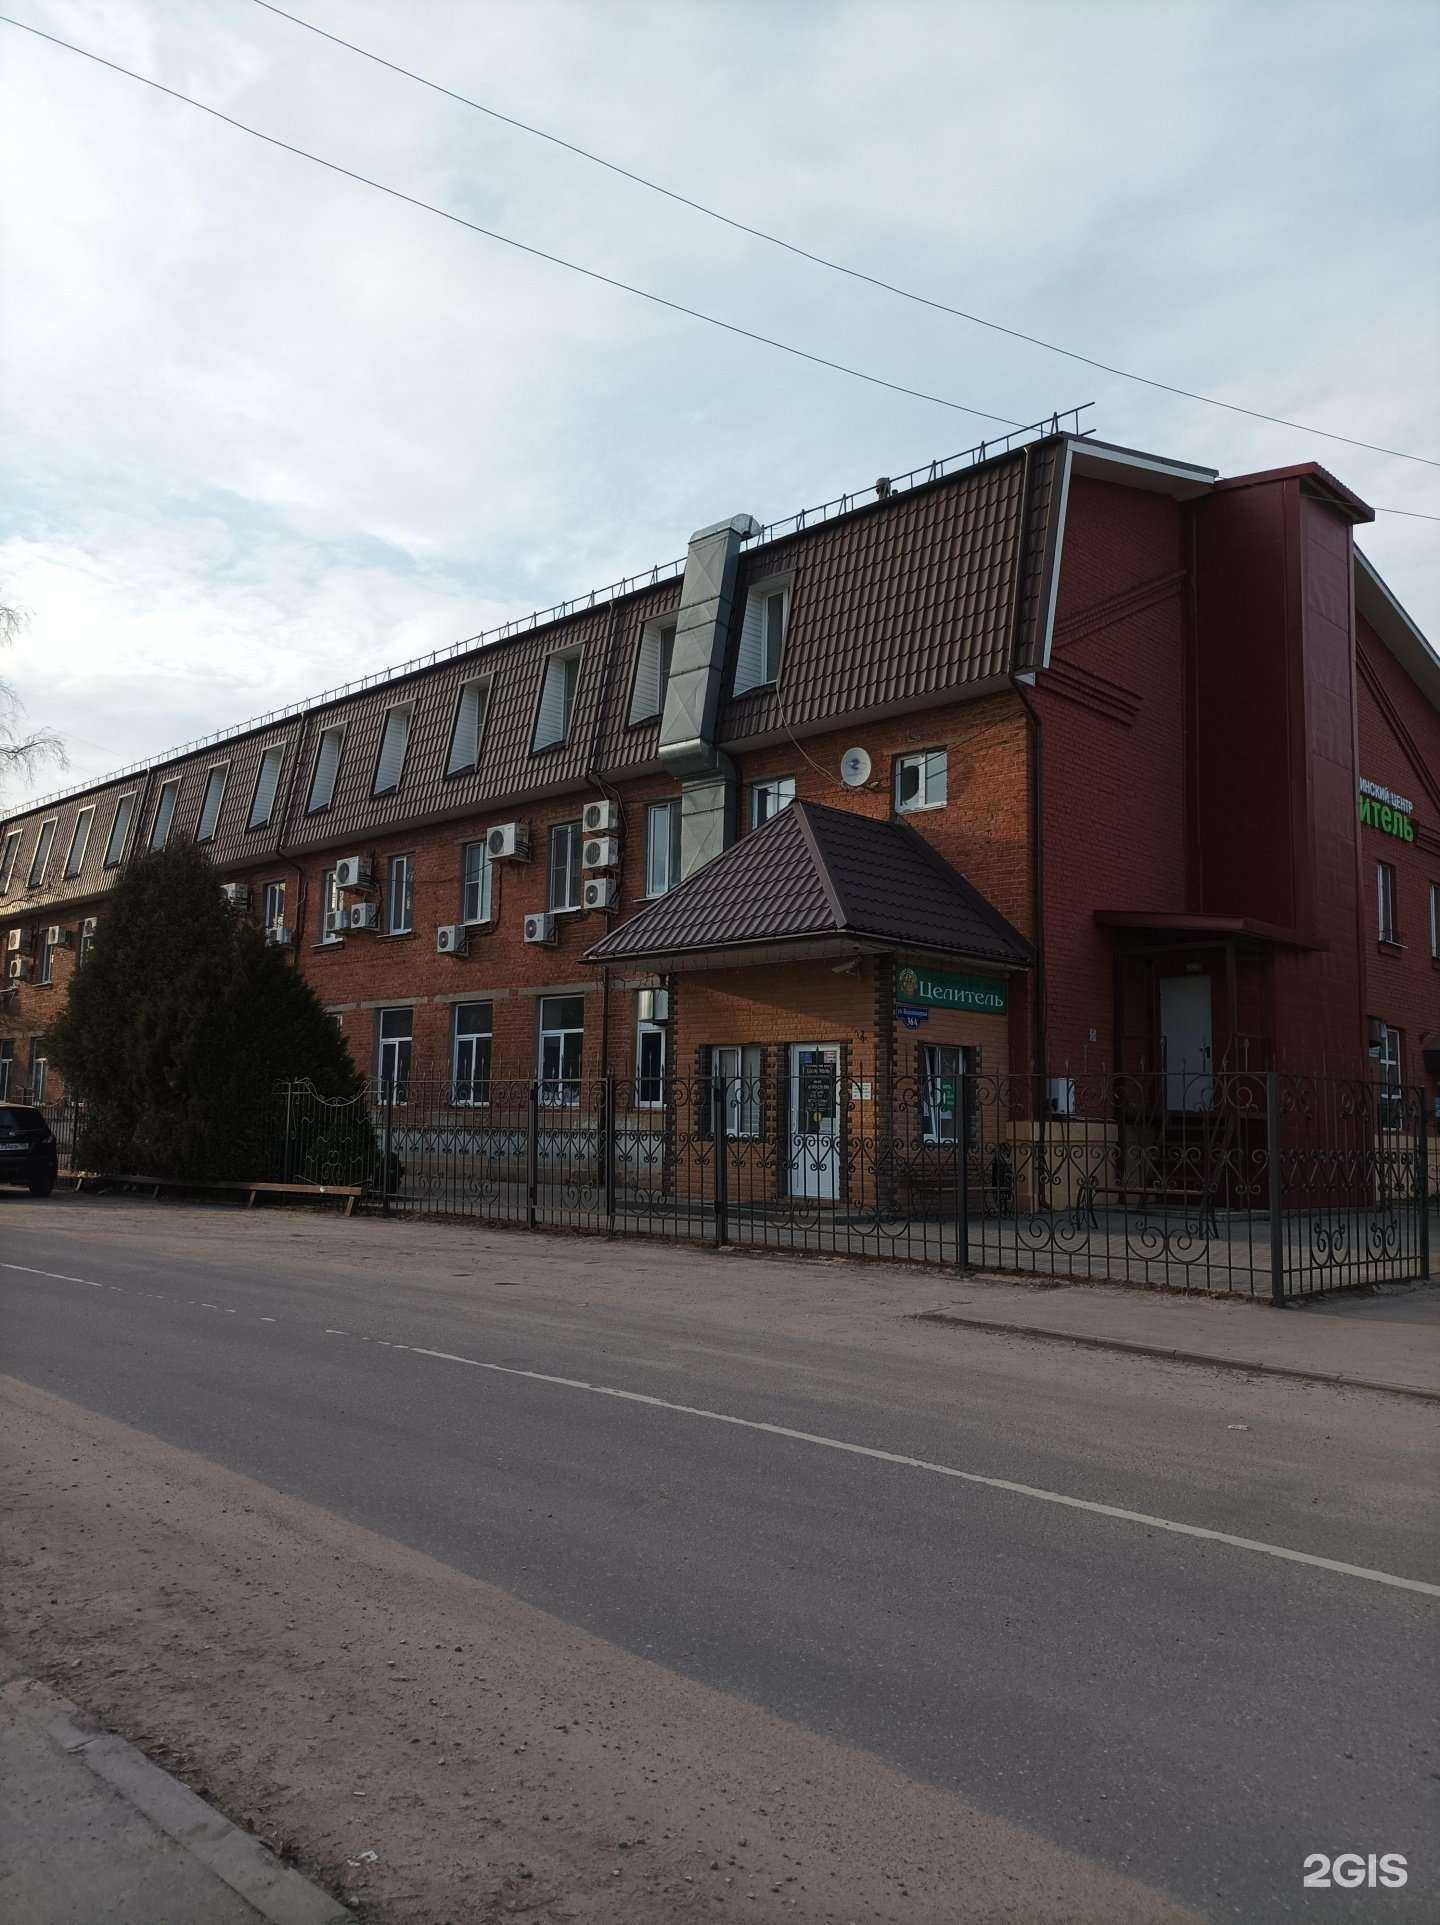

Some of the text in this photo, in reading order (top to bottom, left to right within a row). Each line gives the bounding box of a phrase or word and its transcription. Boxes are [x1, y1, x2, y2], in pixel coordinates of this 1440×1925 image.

[1360, 776, 1413, 815] ИНСКИЙ ЦЕНТР
[1360, 795, 1414, 842] итель
[919, 981, 1004, 1007] Целитель
